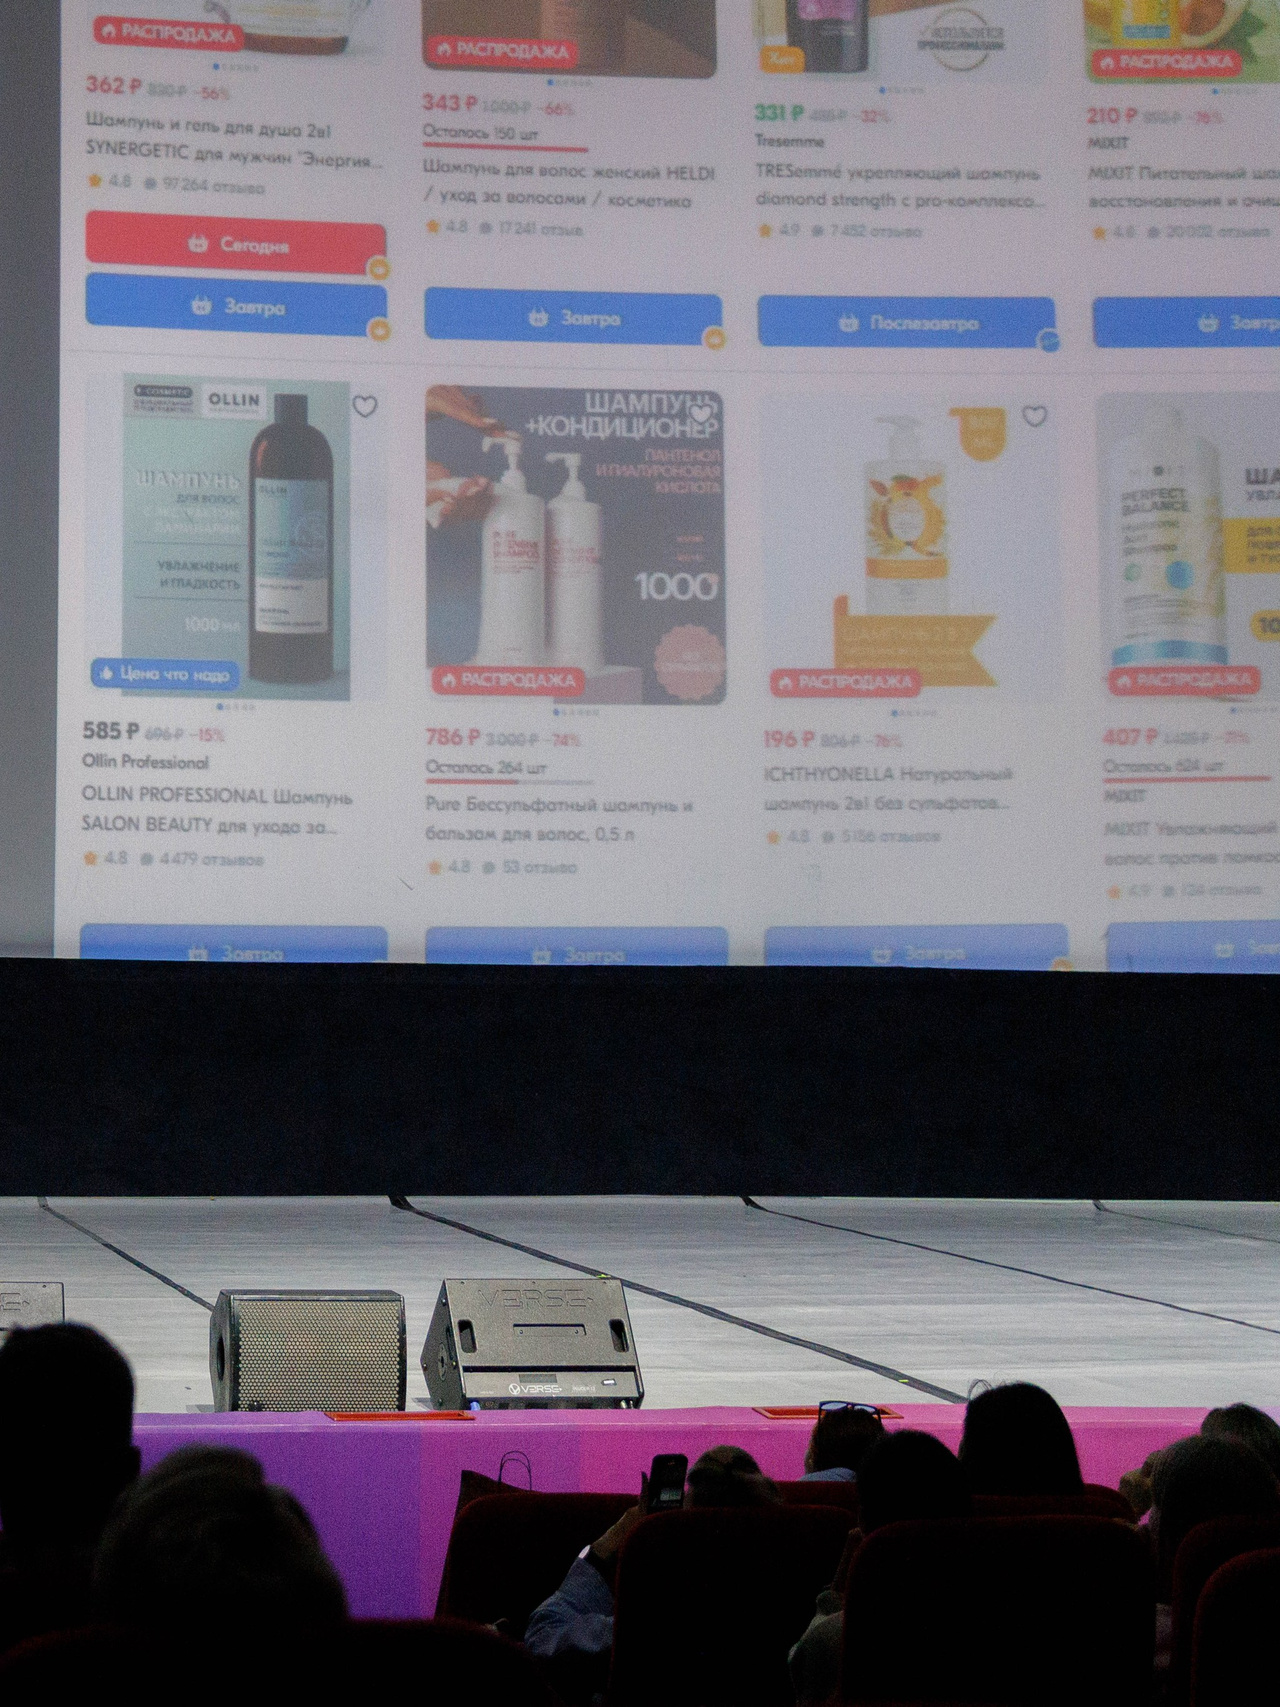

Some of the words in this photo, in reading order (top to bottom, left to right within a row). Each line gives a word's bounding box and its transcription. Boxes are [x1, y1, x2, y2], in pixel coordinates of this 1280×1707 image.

[122, 23, 235, 43] РАСПРОДАЖА
[457, 42, 569, 60] РАСПРОДАЖА
[1121, 54, 1233, 70] РАСПРОДАЖА
[86, 75, 124, 93] 362
[423, 93, 460, 111] 343
[86, 111, 165, 131] Шампунь
[170, 116, 180, 128] и
[185, 118, 220, 134] гель
[225, 122, 253, 136] для
[259, 124, 301, 139] душа
[423, 124, 489, 140] Осталось
[494, 127, 515, 141] 150
[520, 129, 538, 141] шт
[86, 139, 189, 160] SYNERGETIC
[194, 148, 223, 163] для
[229, 151, 291, 167] мужчин
[423, 159, 501, 178] Шампунь
[505, 163, 534, 178] для
[539, 164, 586, 178] волос
[593, 165, 660, 181] женский
[848, 166, 960, 183] укрепляющий
[966, 168, 1041, 184] шампунь
[440, 190, 477, 204] уход
[483, 191, 501, 203] за
[507, 192, 586, 207] волосами
[608, 194, 691, 209] косметика
[756, 191, 826, 207] diamond
[831, 193, 895, 210] strength
[221, 237, 289, 255] Сегодня
[225, 299, 286, 318] Завтра
[562, 310, 621, 328] Завтра
[871, 314, 980, 333] Послезавтра
[208, 392, 260, 406] OLLIN
[136, 470, 241, 489] ШАМПУНЬ
[158, 560, 240, 573] УВЛАЖНЕНИЕ
[170, 578, 240, 590] ГЛАДКОСТЬ
[635, 572, 718, 600] 1000
[120, 665, 160, 683] Цена
[166, 670, 188, 680] что
[194, 670, 230, 683] надо
[462, 671, 575, 689] РАСПРОДАЖА
[798, 675, 912, 690] РАСПРОДАЖА
[82, 721, 121, 740] 585
[426, 728, 463, 746] 786
[764, 730, 798, 747] 196
[82, 753, 117, 769] Ollin
[121, 754, 209, 770] Professional
[426, 760, 494, 774] Осталось
[527, 763, 546, 774] шт
[82, 784, 132, 802] OLLIN
[140, 786, 268, 804] PROFESSIONAL
[274, 790, 353, 808] Шампунь
[426, 796, 461, 812] Pure
[466, 796, 596, 816] Бессульфатный
[603, 801, 679, 816] шампунь
[765, 800, 839, 814] шампунь
[82, 815, 140, 832] SALON
[146, 817, 212, 832] BEAUTY
[217, 820, 246, 834] для
[254, 822, 300, 836] ухода
[426, 827, 496, 841] бальзам
[502, 829, 531, 843] для
[521, 1385, 559, 1394] VERSE
